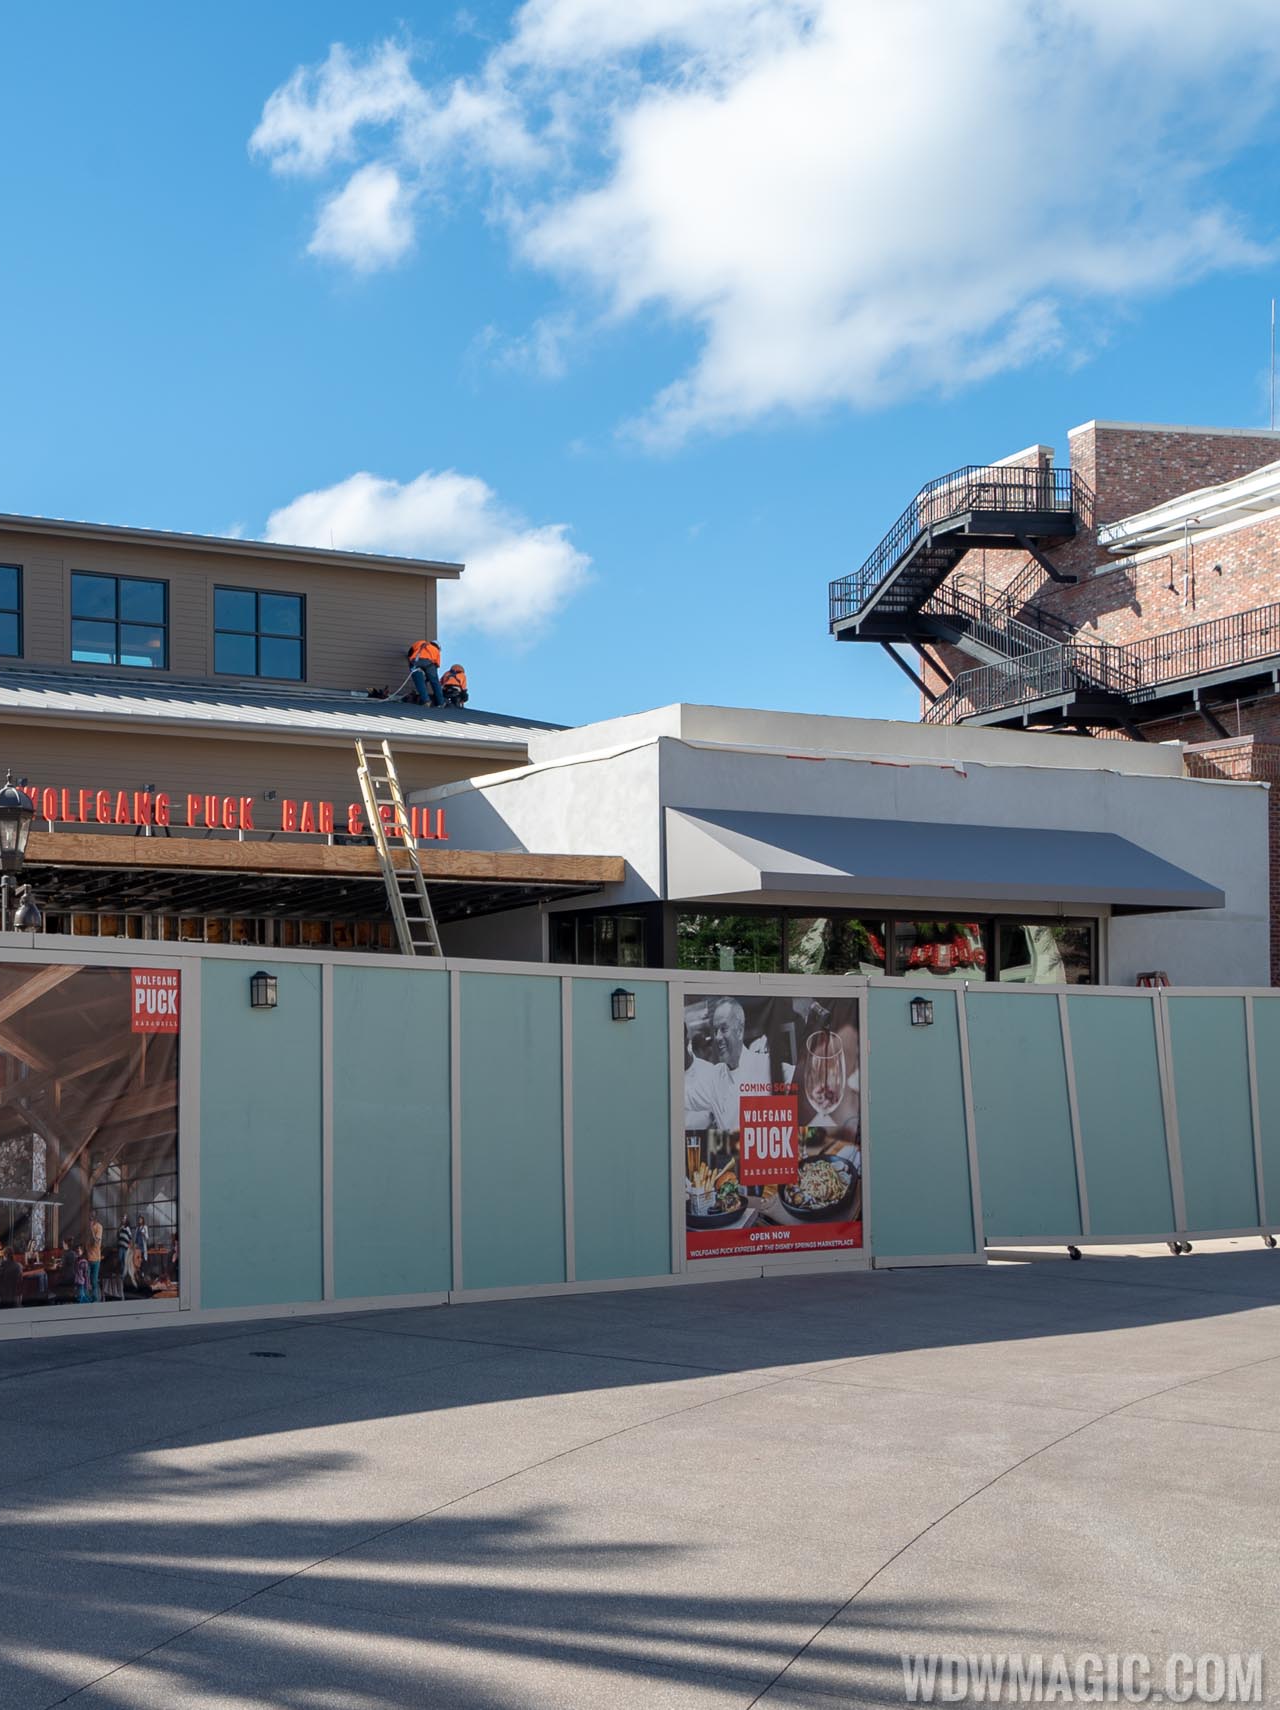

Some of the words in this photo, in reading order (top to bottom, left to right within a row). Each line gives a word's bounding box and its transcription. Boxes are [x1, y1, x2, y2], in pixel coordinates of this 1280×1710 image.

[187, 793, 254, 830] PUCK
[282, 799, 334, 834] BAR
[348, 803, 363, 835] &
[135, 975, 177, 986] WOLFGANG
[135, 988, 177, 1014] PUCK
[740, 1083, 771, 1093] COMING
[743, 1109, 793, 1122] WOLFGANG
[744, 1126, 794, 1160] PUCK
[750, 1232, 770, 1241] OPEN
[772, 1231, 790, 1240] NOW
[690, 1248, 720, 1257] WOLFGANG
[720, 1247, 734, 1255] PUCK
[734, 1245, 756, 1253] EXPRESS
[775, 1242, 794, 1250] DISNEY
[795, 1241, 817, 1249] SPRINGS
[818, 1239, 854, 1247] MARKETPLACE
